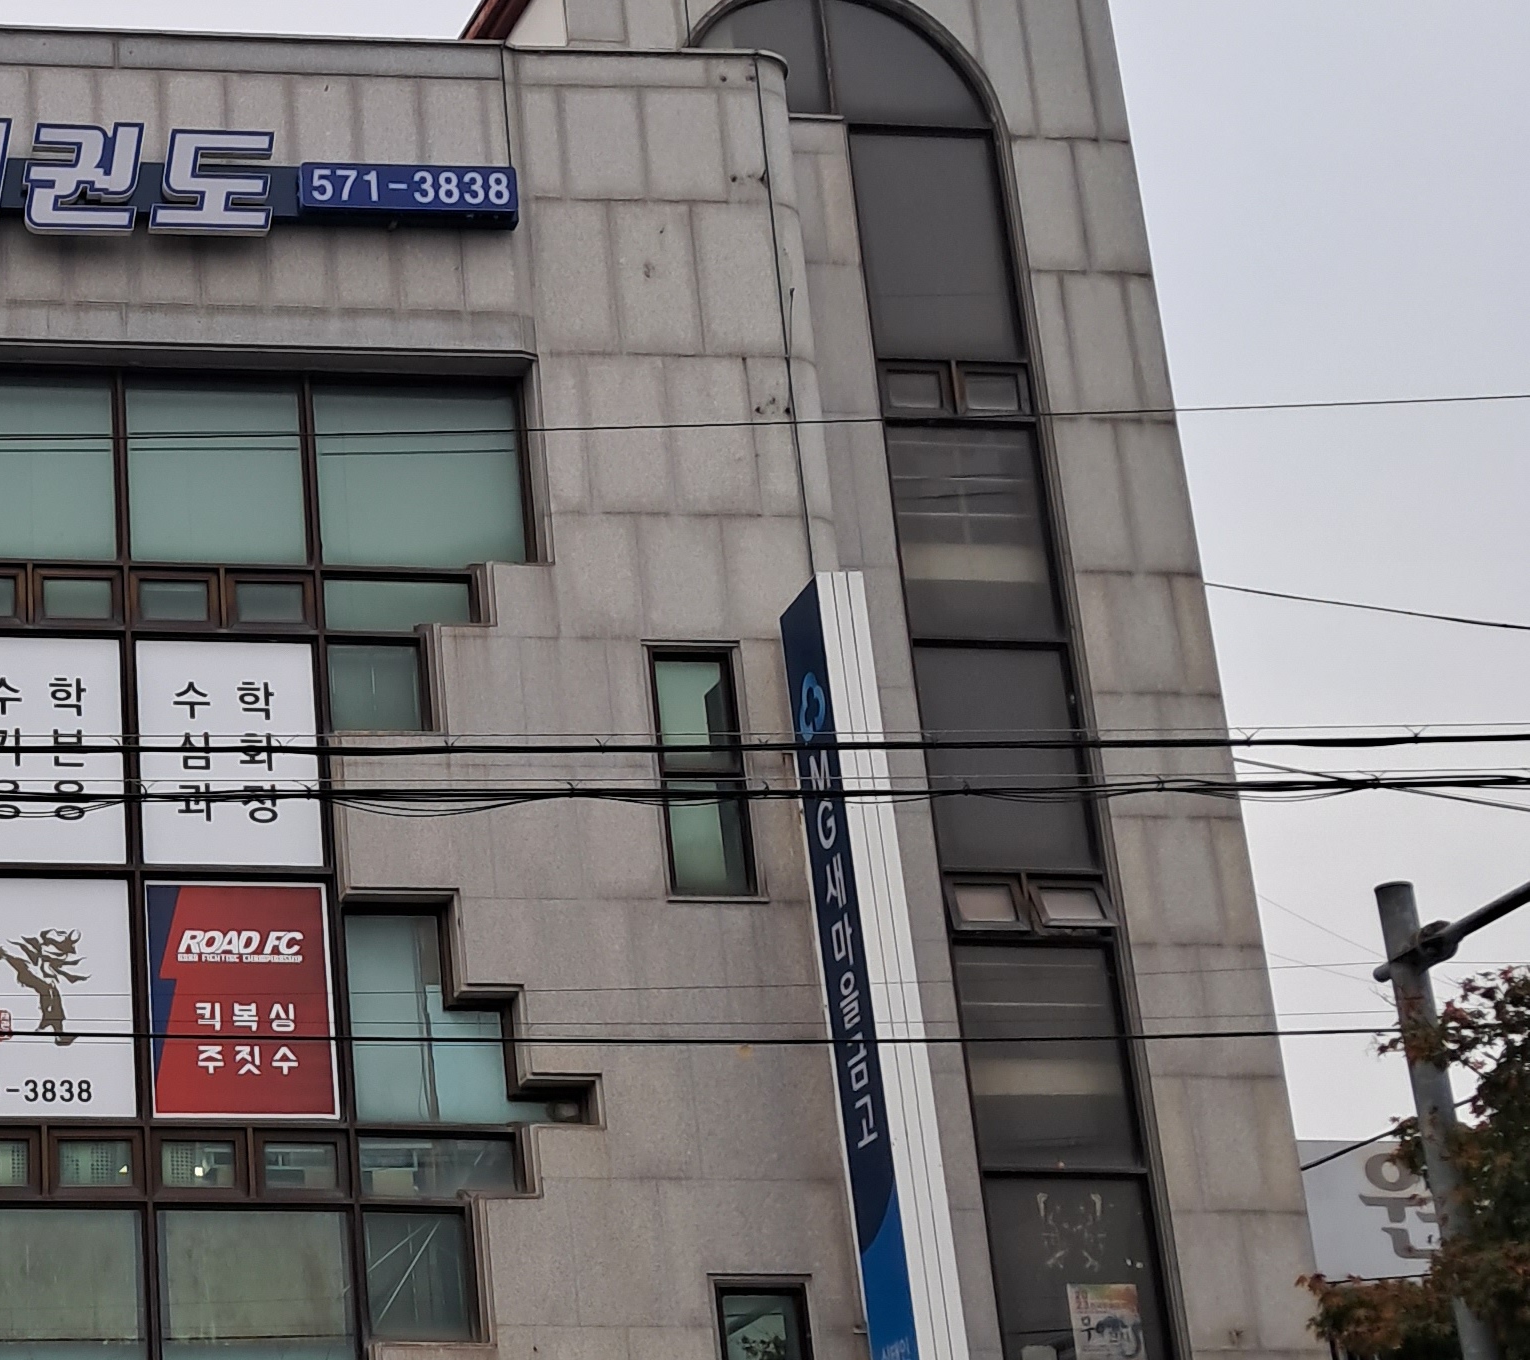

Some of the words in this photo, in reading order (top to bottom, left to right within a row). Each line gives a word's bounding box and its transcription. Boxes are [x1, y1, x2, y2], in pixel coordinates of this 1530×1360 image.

[311, 169, 510, 205] 571-3838
[173, 681, 275, 721] 수학
[178, 929, 260, 954] ROAD
[263, 931, 304, 955] FC
[195, 1002, 297, 1033] 킥복싱
[197, 1046, 300, 1076] 주짓수
